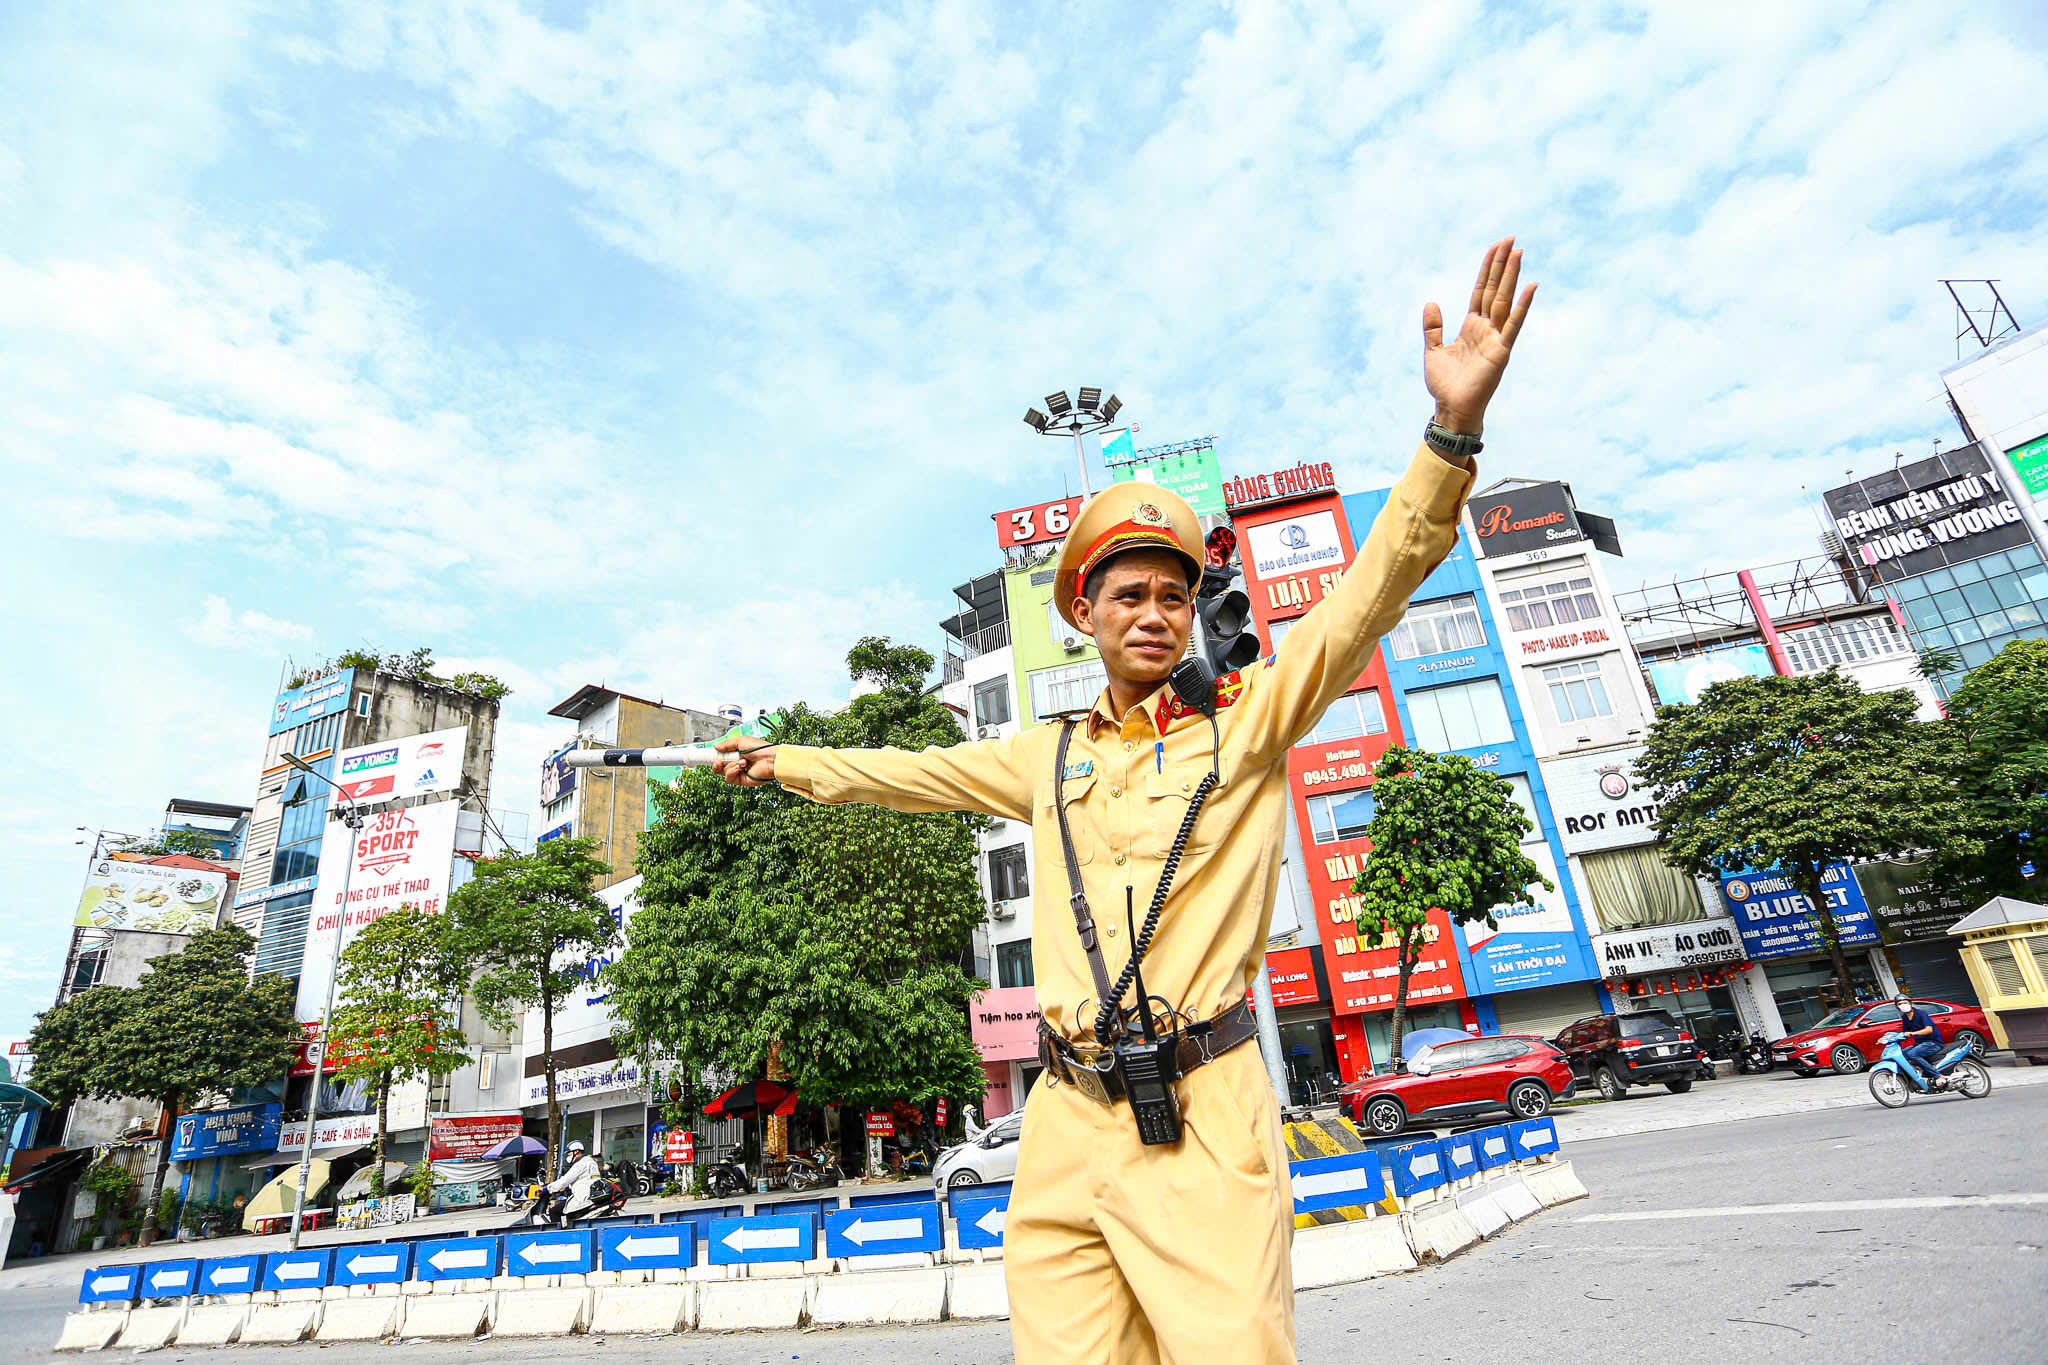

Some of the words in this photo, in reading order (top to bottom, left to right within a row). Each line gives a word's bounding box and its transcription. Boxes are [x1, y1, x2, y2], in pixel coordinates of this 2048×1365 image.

[1222, 474, 1270, 505] CÔNG
[1273, 460, 1335, 494] CHỨNG
[1836, 509, 1893, 541] BỆNH
[1891, 489, 1940, 521] VIỆN
[1939, 471, 1983, 507] THÚ
[1976, 470, 2001, 493] Y
[1011, 500, 1084, 541] 36
[1477, 504, 1565, 538] Romantic
[1928, 500, 2022, 544] VƯƠNG
[1545, 528, 1578, 541] Studio
[1525, 550, 1548, 562] 369
[1267, 575, 1312, 610] LUẬT
[1521, 639, 1546, 654] PHOTO
[1548, 634, 1569, 649] MAKE
[1568, 632, 1579, 647] UP
[1582, 628, 1610, 645] BRIDAL
[1417, 656, 1475, 673] PLATINUM
[364, 750, 396, 768] YONEX
[1326, 749, 1360, 763] Hotline
[375, 808, 406, 832] 357
[357, 830, 419, 858] SPORT
[1324, 852, 1358, 882] VĂN
[404, 878, 430, 893] THAO
[1750, 877, 1786, 895] PHÒNG
[1839, 866, 1848, 880] Y
[1897, 885, 1922, 896] NAIL
[1329, 892, 1366, 924] CÔN
[1604, 941, 1635, 962] ẢNH
[1675, 933, 1695, 952] ÁO
[1761, 936, 1799, 948] GROOMING
[1804, 932, 1820, 941] SPA
[1490, 960, 1513, 974] TÂN
[1515, 956, 1543, 971] THỜI
[1545, 955, 1567, 968] ĐẠI
[1608, 964, 1627, 976] 369
[1286, 972, 1308, 982] LONG
[979, 1012, 1001, 1024] Tiệm
[1004, 1011, 1023, 1022] hoa
[205, 1115, 225, 1129] NHA
[227, 1111, 254, 1126] KHOA
[216, 1127, 238, 1143] VINA
[322, 1129, 338, 1142] CAFE
